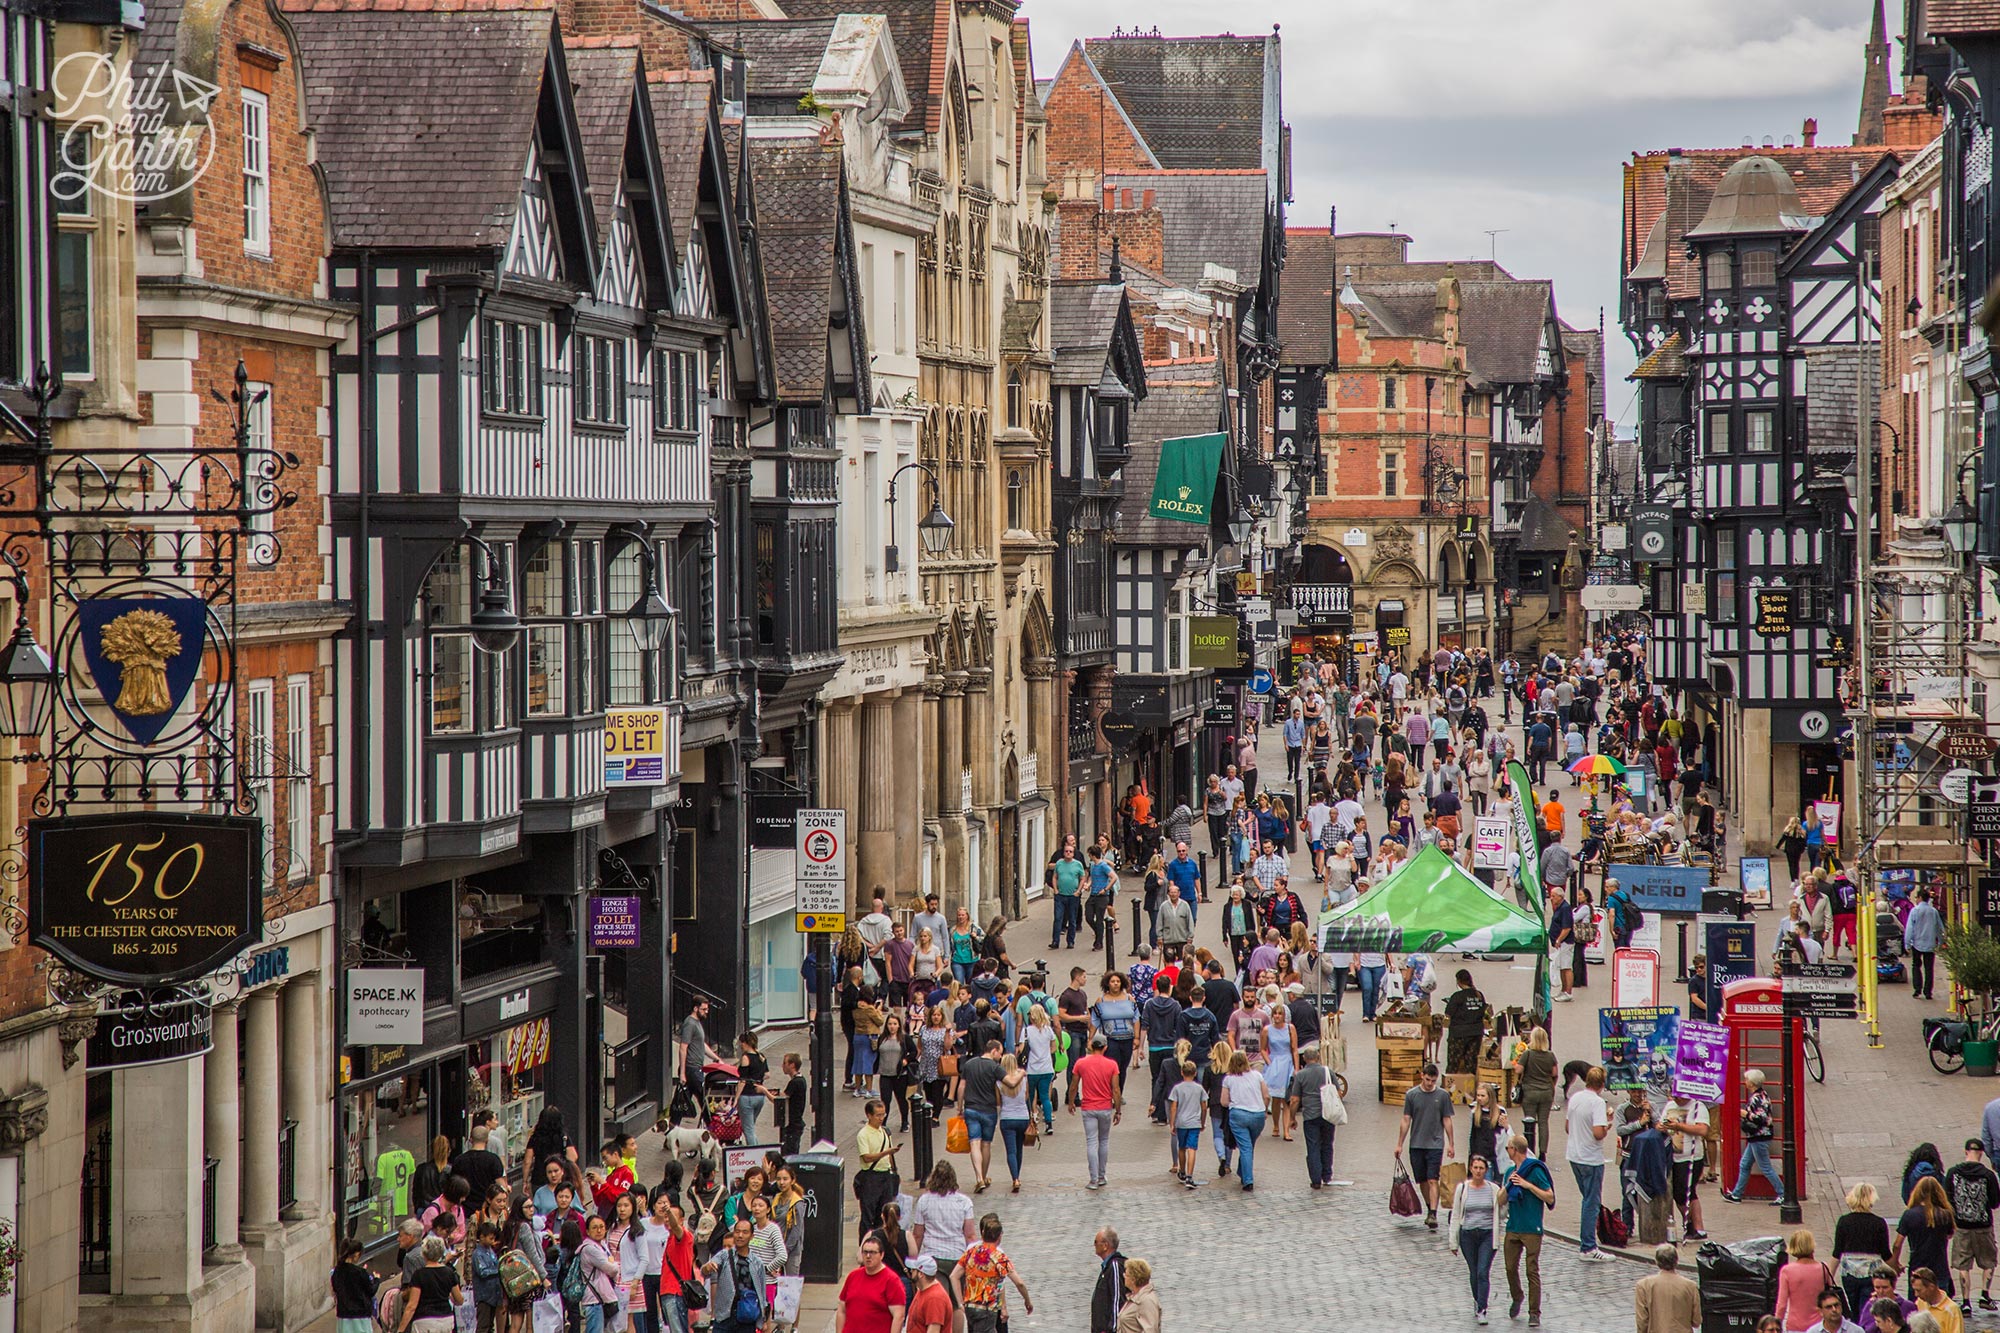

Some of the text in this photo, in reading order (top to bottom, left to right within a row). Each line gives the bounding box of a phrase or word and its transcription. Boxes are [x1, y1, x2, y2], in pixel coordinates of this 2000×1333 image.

[1157, 499, 1204, 515] ROLEX
[1636, 511, 1671, 521] FATFACE
[1685, 586, 1698, 597] The
[1761, 595, 1770, 604] Ye
[1762, 604, 1787, 614] Boot
[1764, 615, 1784, 623] Inn
[1194, 634, 1230, 646] hotter
[851, 645, 898, 675] DEBENHAMS
[627, 714, 659, 728] SHOP
[623, 730, 656, 751] LET
[1950, 737, 1987, 746] BELLA
[1949, 747, 1988, 755] ITALIA
[805, 818, 837, 827] ZONE
[1479, 827, 1505, 837] CAFE
[86, 832, 205, 906] 150
[1631, 884, 1687, 898] NERO
[112, 908, 178, 920] YEARS OF
[596, 916, 633, 924] TO LET
[51, 926, 237, 938] THE CHESTER GROSVENOR
[112, 944, 139, 955] 1865
[150, 944, 178, 955] 2015
[241, 946, 289, 988] OFFICE
[1713, 964, 1728, 973] The
[1625, 970, 1647, 978] 40%
[353, 988, 416, 1001] SPACE.NK
[359, 1006, 410, 1016] apothecary
[1604, 1009, 1618, 1018] 5/7
[1620, 1008, 1657, 1016] WATERGATE
[111, 1022, 190, 1048] Grosvenor
[536, 1017, 550, 1064] Sale
[507, 1026, 522, 1076] Sale
[522, 1022, 535, 1070] Sale
[1682, 1057, 1704, 1069] funky
[394, 1162, 407, 1188] 19
